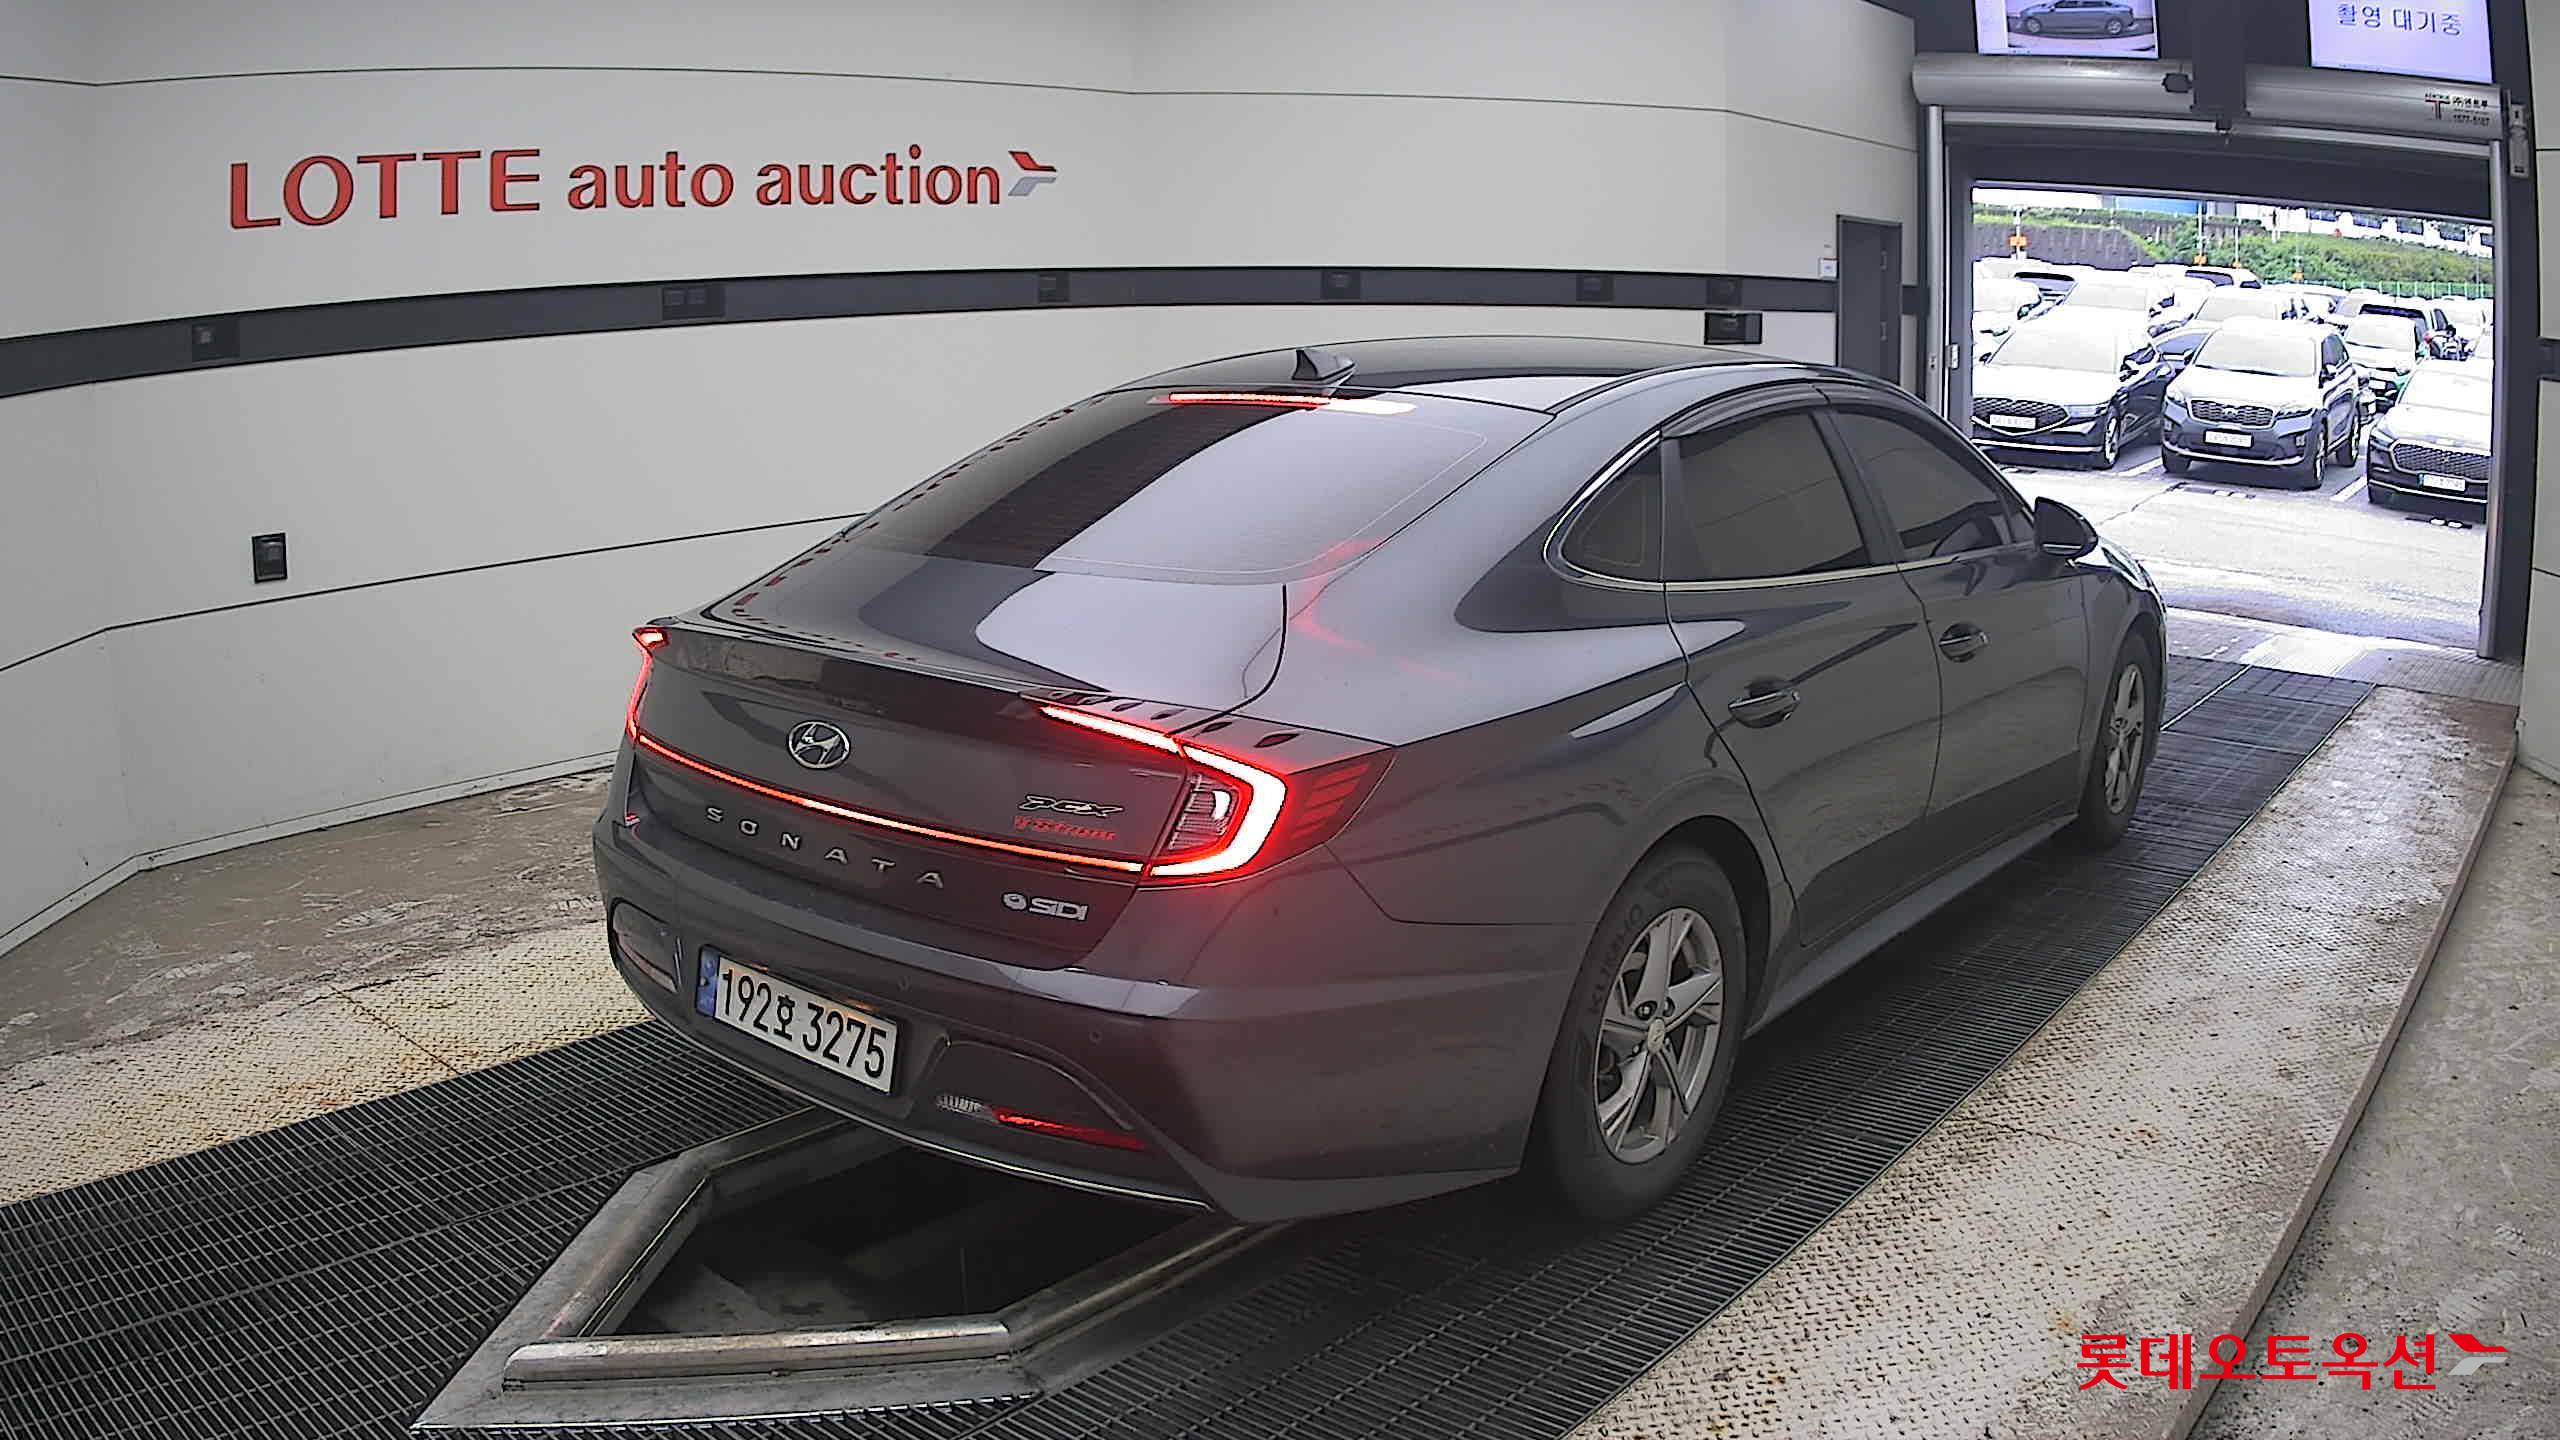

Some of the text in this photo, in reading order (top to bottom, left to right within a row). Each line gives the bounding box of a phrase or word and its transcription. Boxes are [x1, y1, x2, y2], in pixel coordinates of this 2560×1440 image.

[2337, 3, 2462, 36] 촬영 대기중
[229, 144, 1002, 230] LOTTE auto auction
[706, 806, 945, 889] SONATA
[721, 967, 888, 1079] 192호 3275
